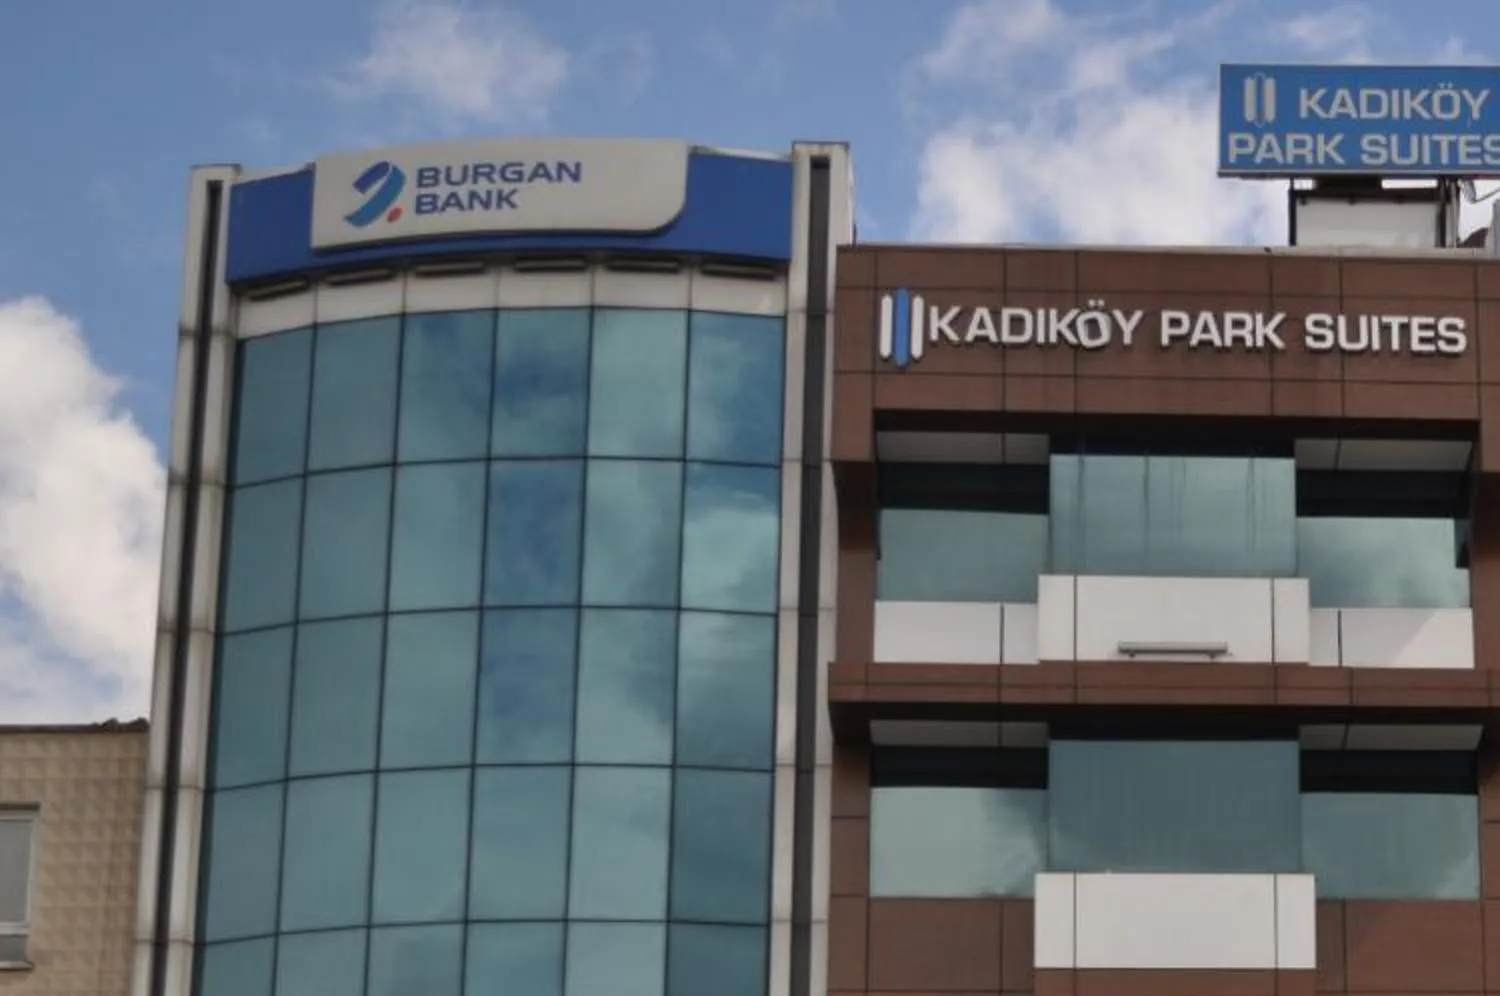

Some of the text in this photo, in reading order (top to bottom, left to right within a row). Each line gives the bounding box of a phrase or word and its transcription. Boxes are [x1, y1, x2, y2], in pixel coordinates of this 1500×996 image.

[1299, 82, 1490, 121] KADIKÖY
[1227, 132, 1346, 165] PARK
[415, 159, 582, 190] BURGAN
[414, 187, 519, 215] BANK
[928, 300, 1469, 354] KADIKÖY PARK SUITES
